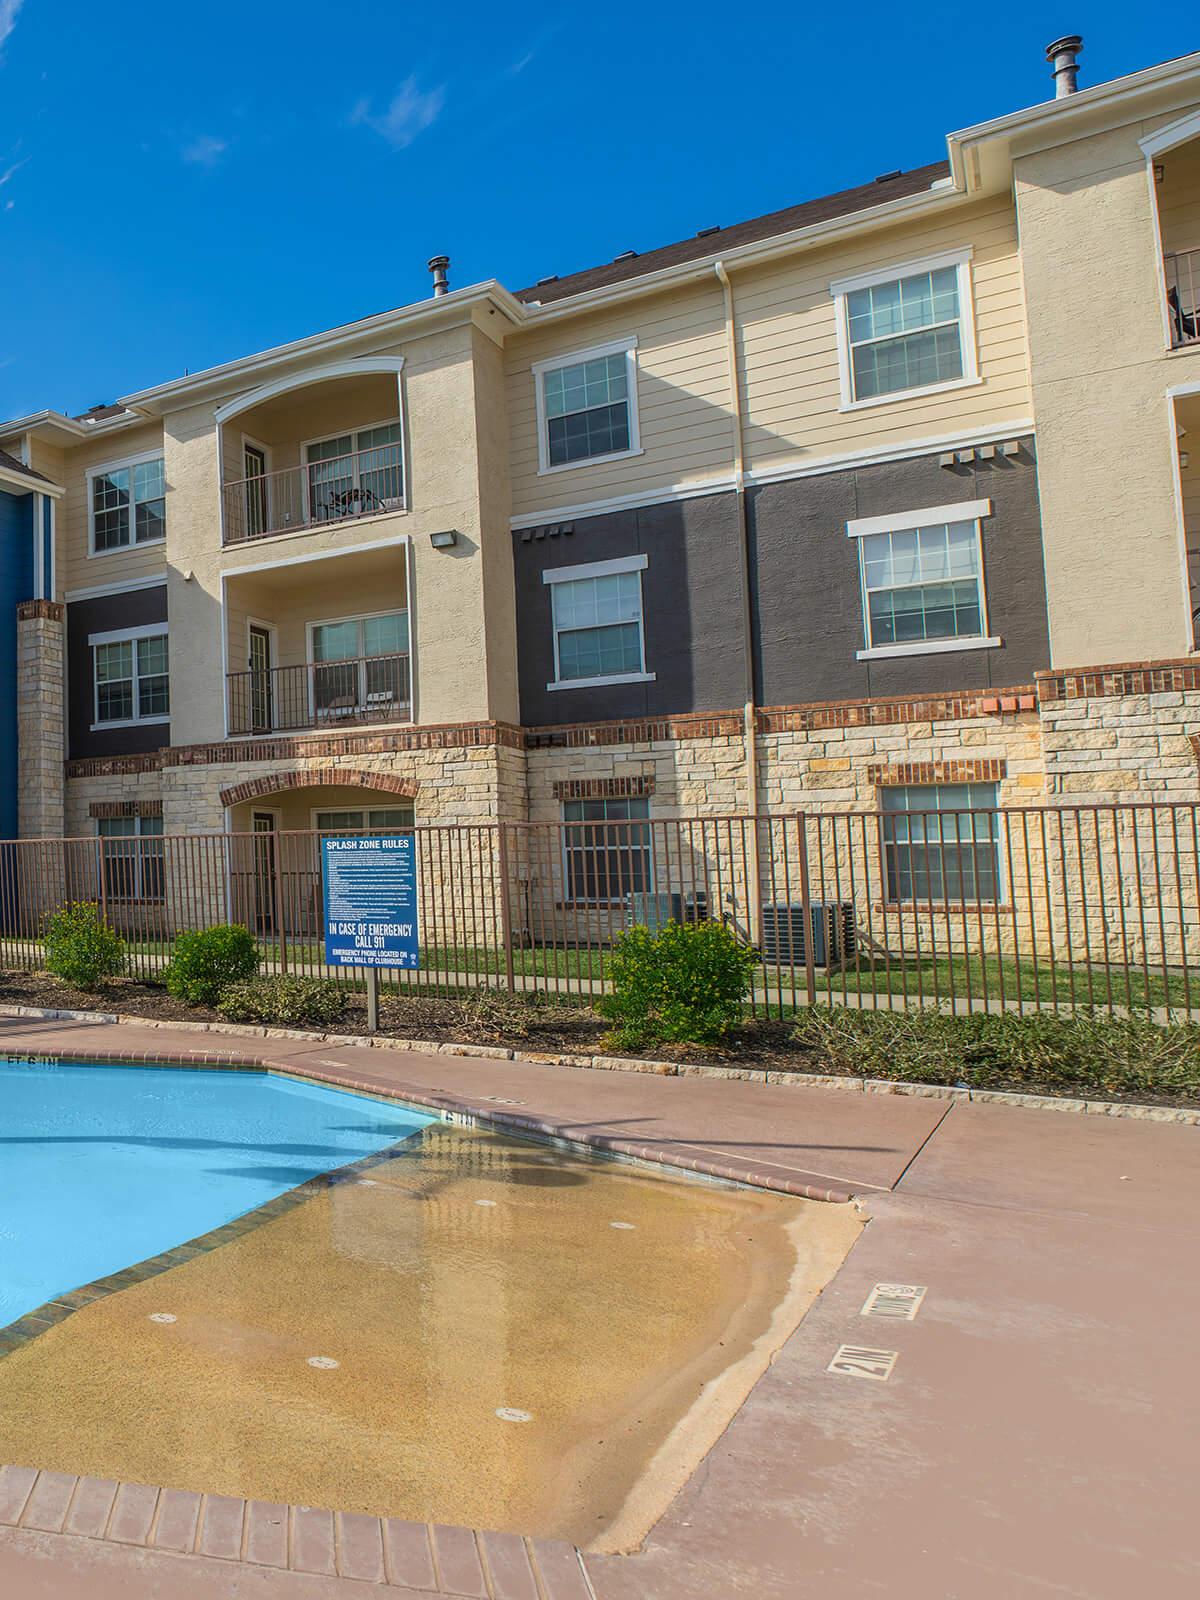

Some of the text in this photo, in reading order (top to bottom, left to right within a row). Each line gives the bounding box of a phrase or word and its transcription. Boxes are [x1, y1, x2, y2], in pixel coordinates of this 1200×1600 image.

[326, 839, 409, 849] SPLASH ZONE RULES
[328, 922, 413, 937] IN CASE OF EMERGENCY
[355, 936, 385, 949] CALL 911
[332, 948, 407, 959] EMERGENCY PHONE LOCATED ON
[340, 955, 354, 963] BACK
[354, 956, 367, 964] WALL
[375, 957, 404, 965] CLUBHOUSE
[833, 1362, 887, 1376] 2
